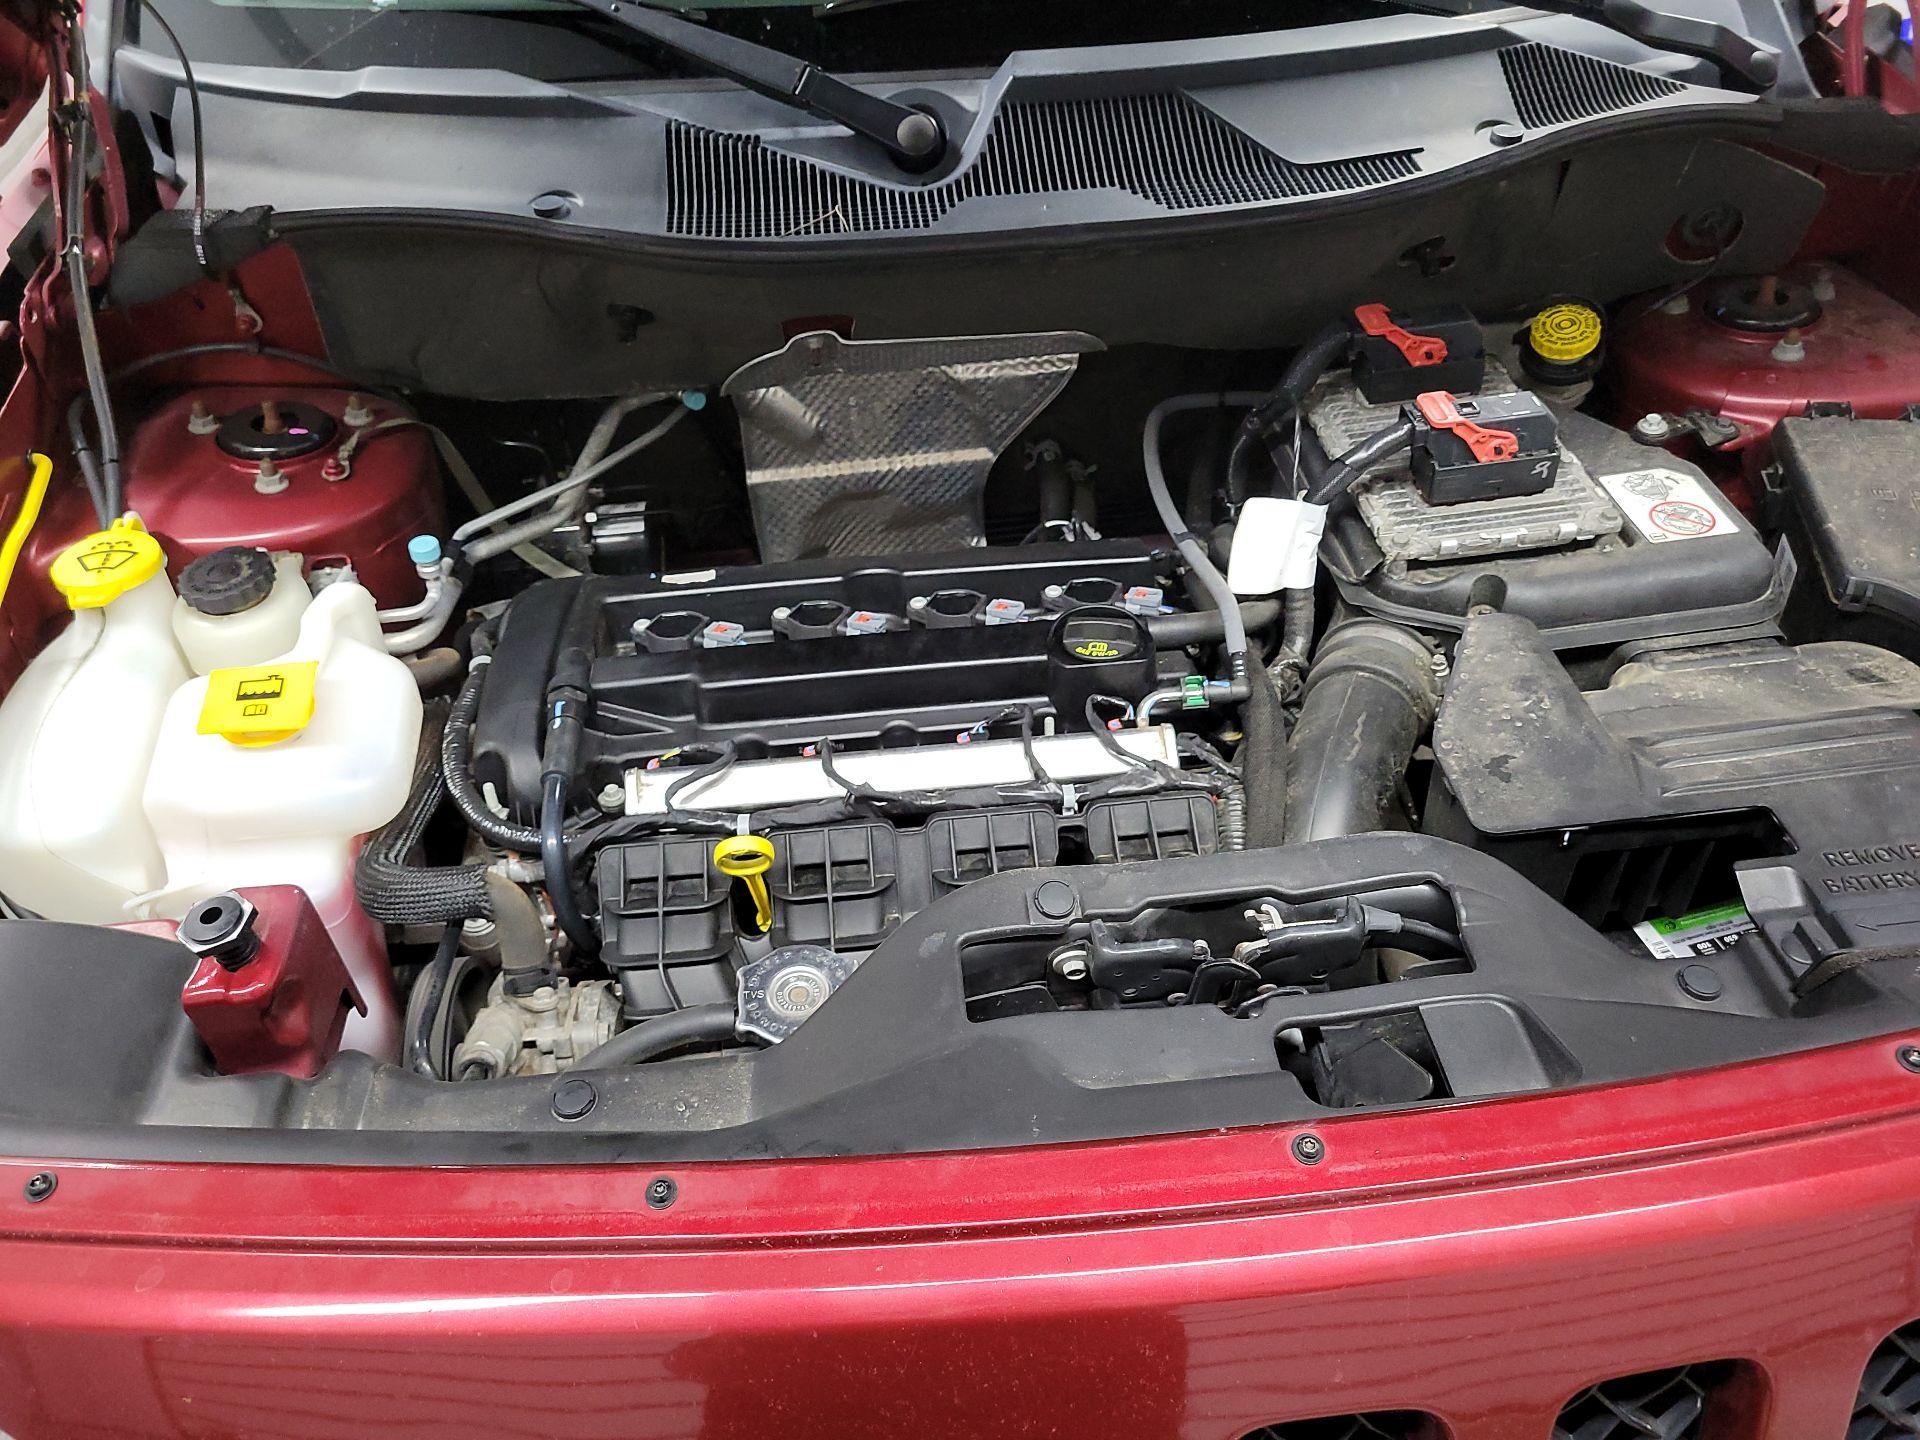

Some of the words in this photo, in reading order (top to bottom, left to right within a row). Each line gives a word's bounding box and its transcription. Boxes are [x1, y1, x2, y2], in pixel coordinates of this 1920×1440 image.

[1822, 843, 1920, 868] REMOVE
[1821, 870, 1920, 894] BATTERY
[743, 990, 765, 999] TVS
